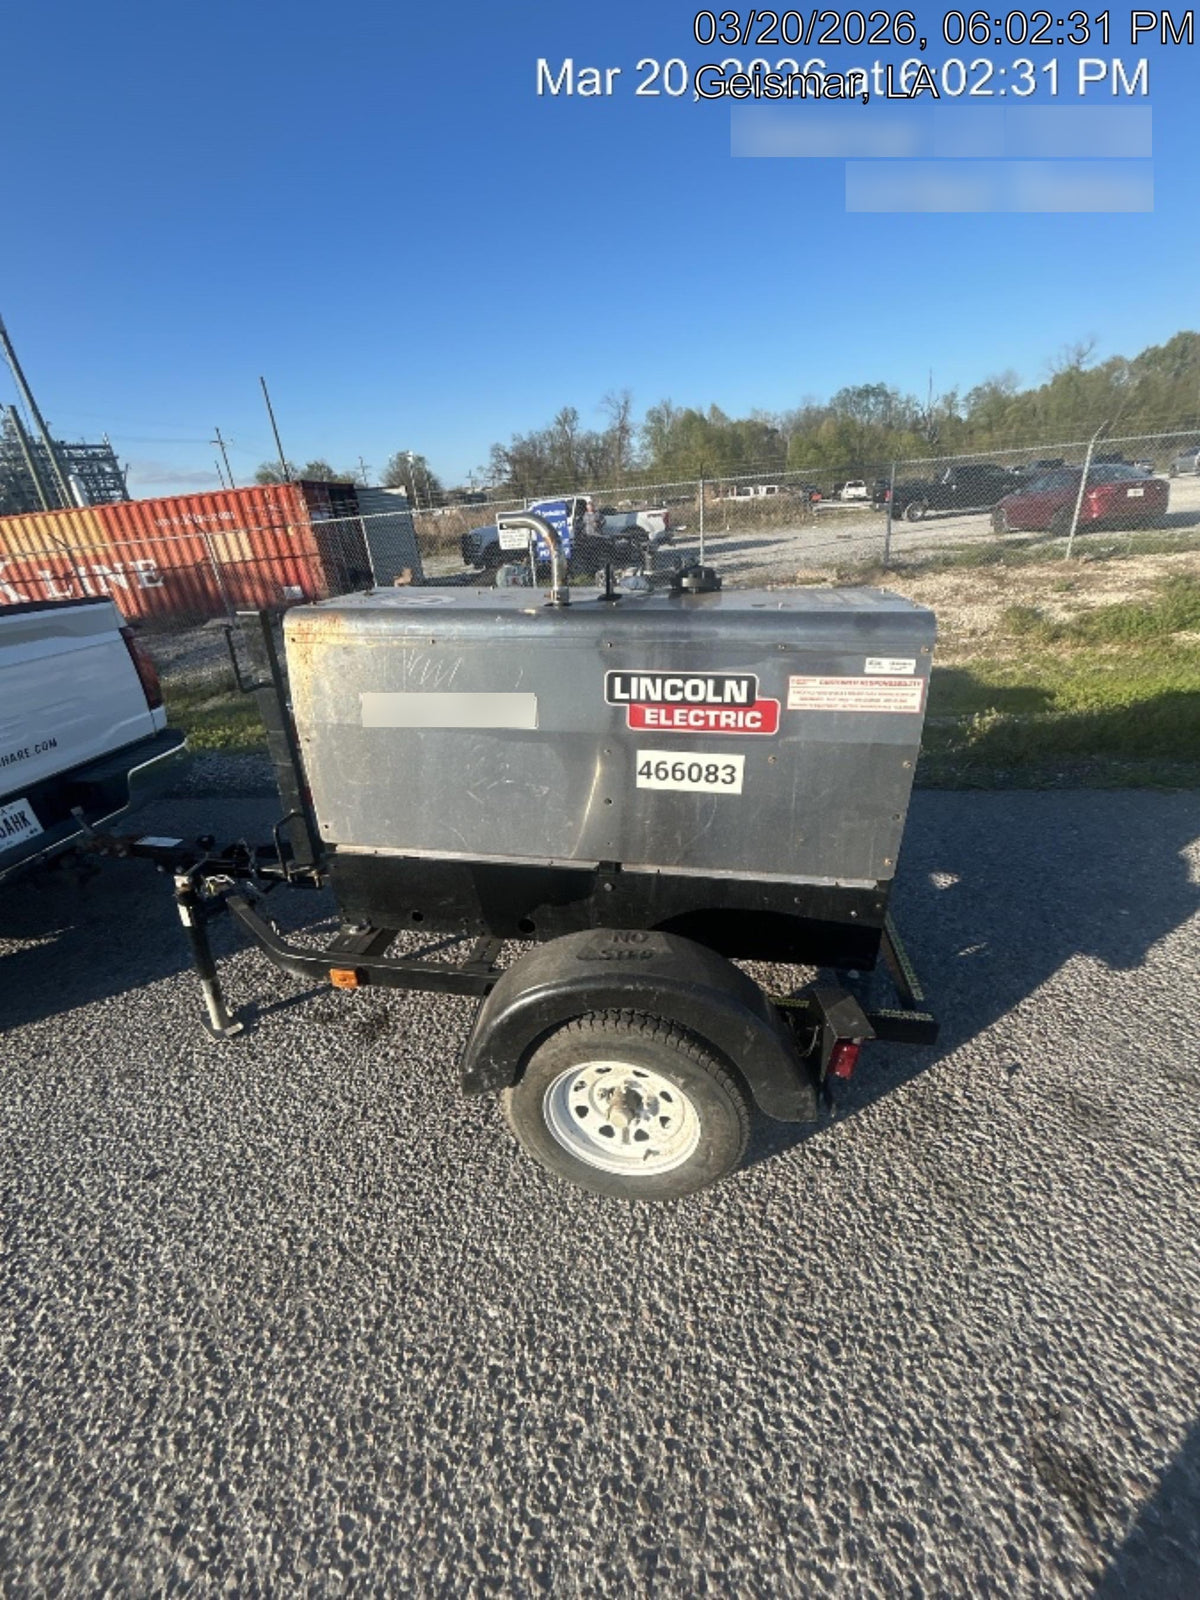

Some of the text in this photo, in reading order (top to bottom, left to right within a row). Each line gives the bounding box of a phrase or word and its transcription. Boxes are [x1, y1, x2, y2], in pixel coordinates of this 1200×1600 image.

[38, 559, 164, 600] LINE
[613, 676, 748, 703] LINCOLN
[644, 707, 762, 729] ELECTRIC
[0, 738, 57, 767] HARE.COM
[637, 759, 737, 786] 466083
